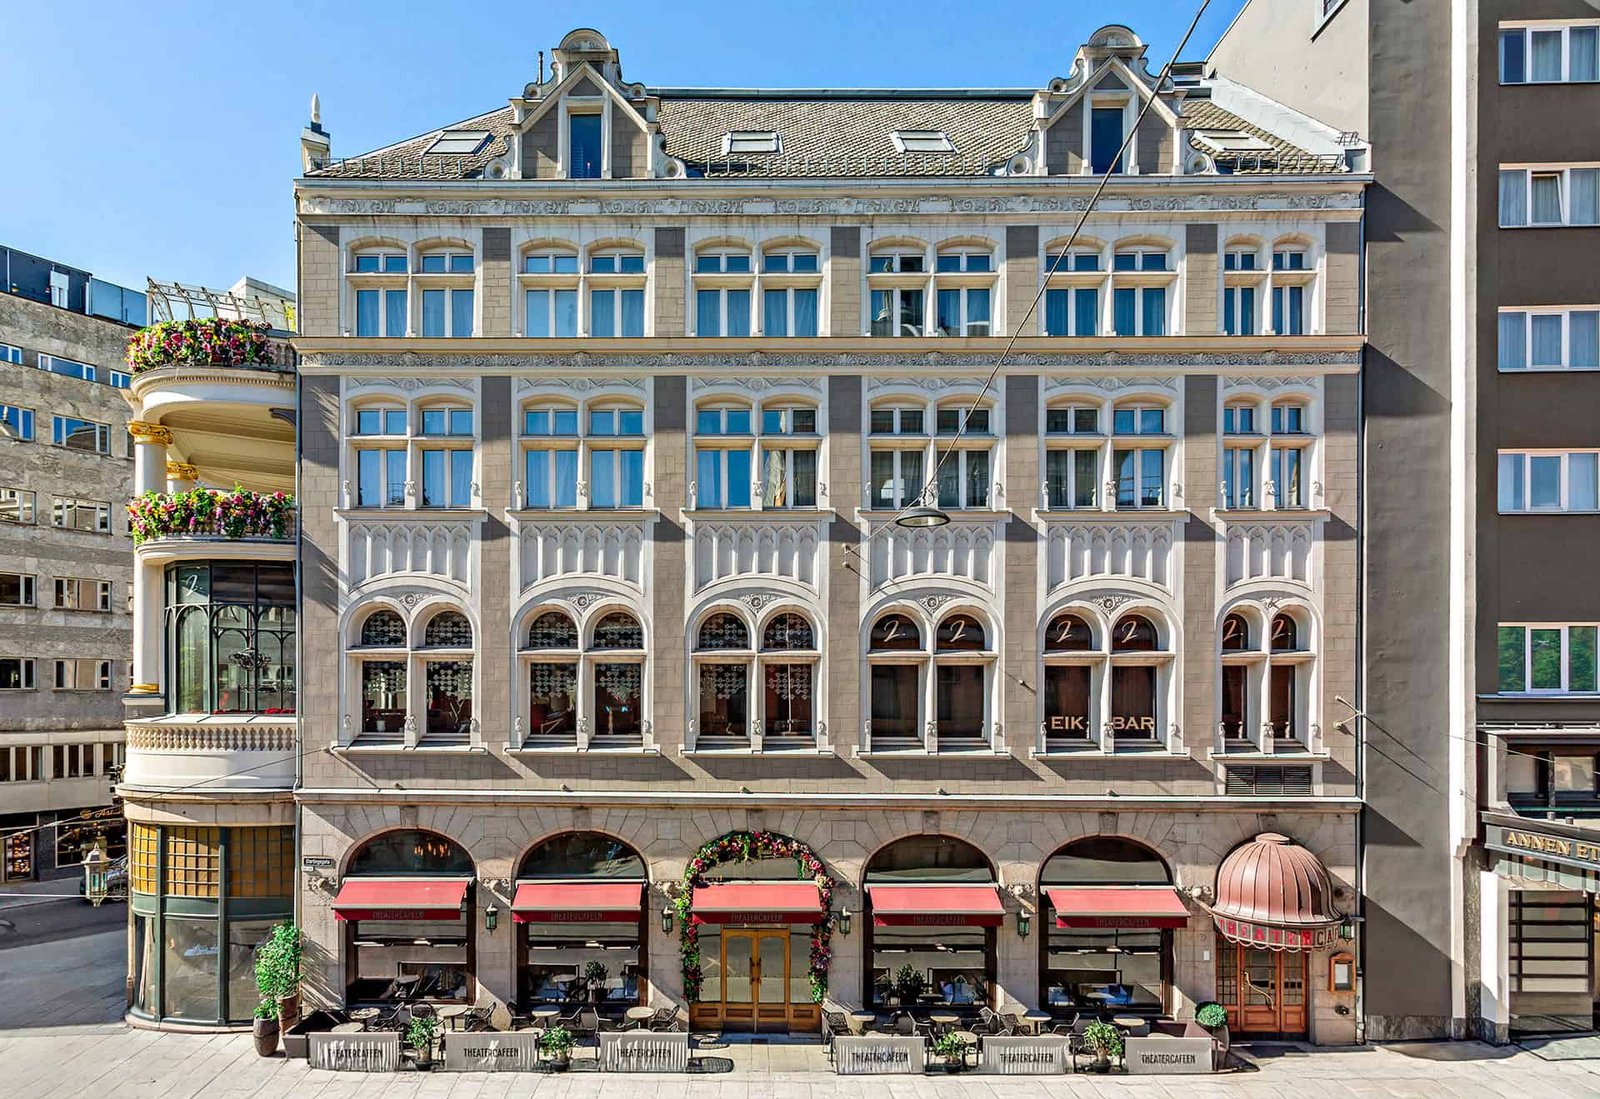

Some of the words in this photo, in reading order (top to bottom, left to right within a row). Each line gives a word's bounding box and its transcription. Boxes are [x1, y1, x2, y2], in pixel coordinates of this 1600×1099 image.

[1051, 716, 1084, 730] EIK
[1112, 716, 1154, 730] BAR
[1507, 831, 1572, 856] ANNEN
[463, 1048, 519, 1058] THEATERCAFEEN
[999, 1053, 1054, 1063] THEATERCAFEEN
[1141, 1054, 1196, 1064] THEATERCAFEEN
